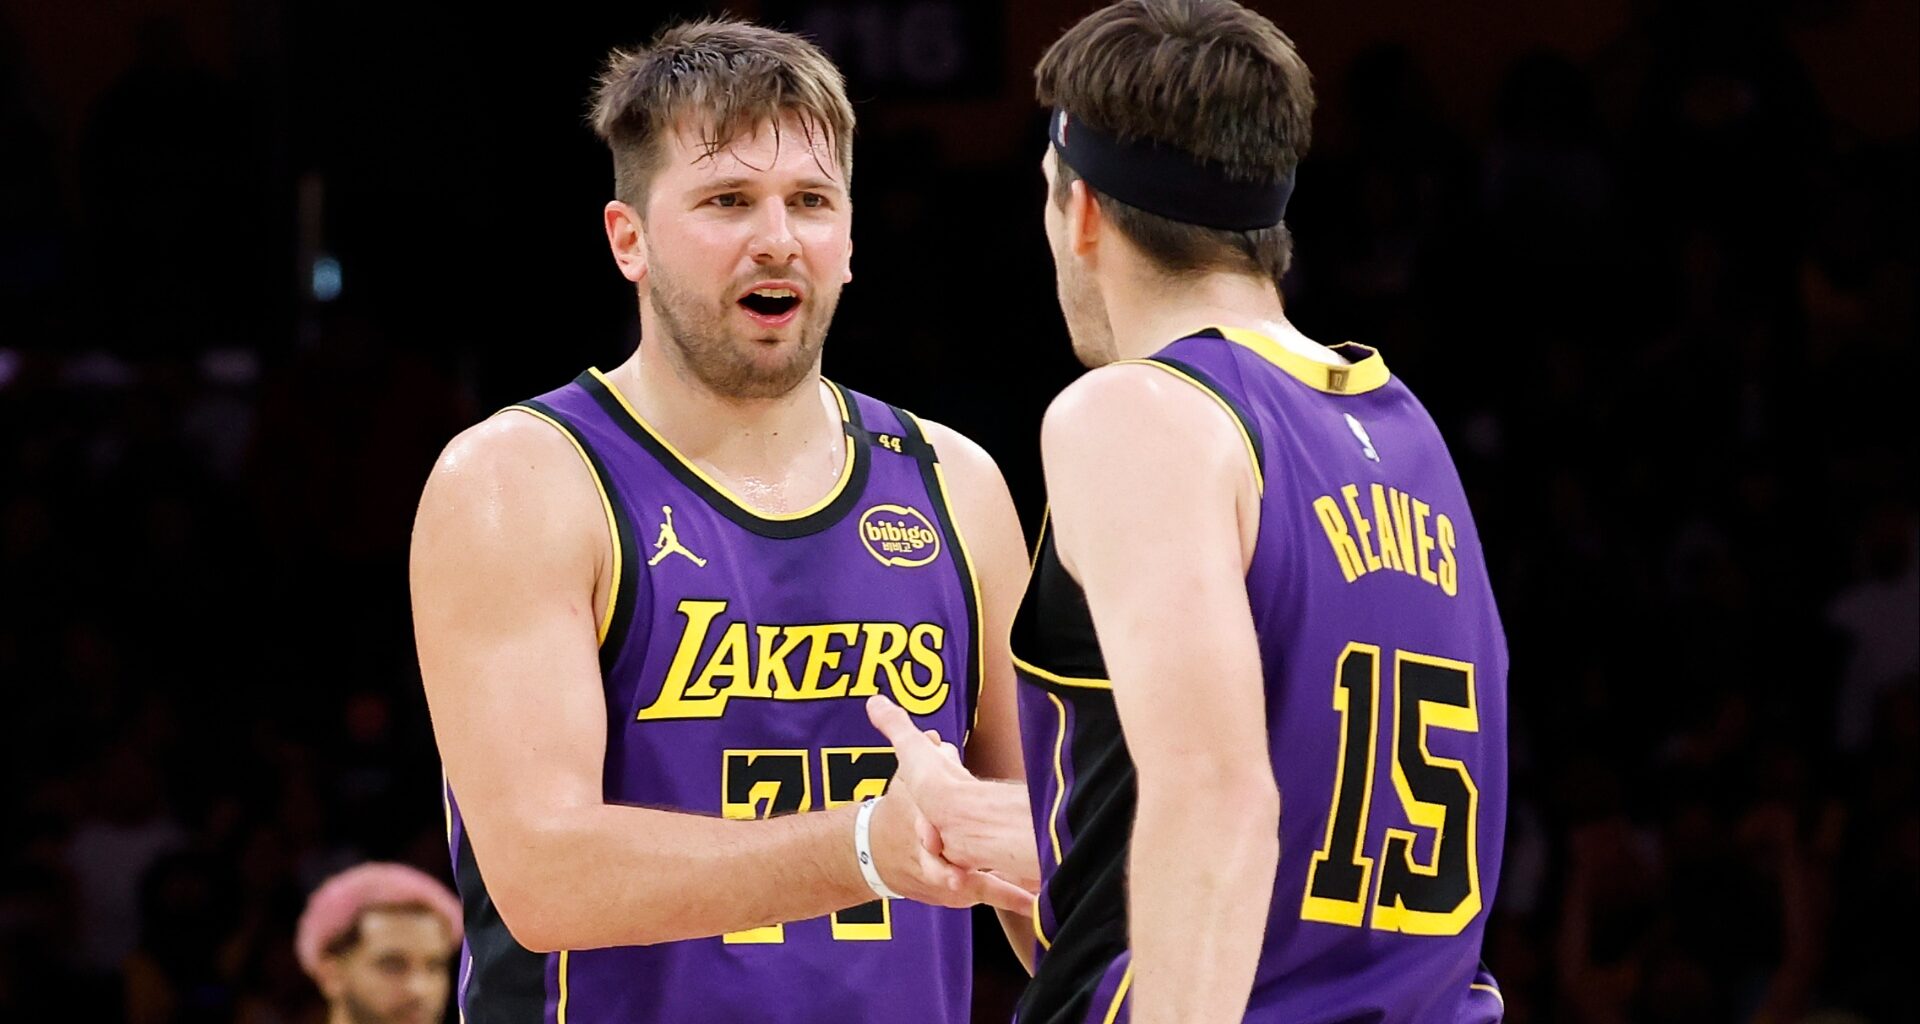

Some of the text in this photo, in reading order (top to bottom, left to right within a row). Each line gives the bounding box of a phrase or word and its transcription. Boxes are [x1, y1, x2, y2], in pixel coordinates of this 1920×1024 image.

[879, 434, 902, 452] 44
[865, 521, 934, 548] bibigo
[1313, 483, 1458, 597] REAVES
[637, 599, 950, 720] LAKERS
[1299, 641, 1482, 936] 15
